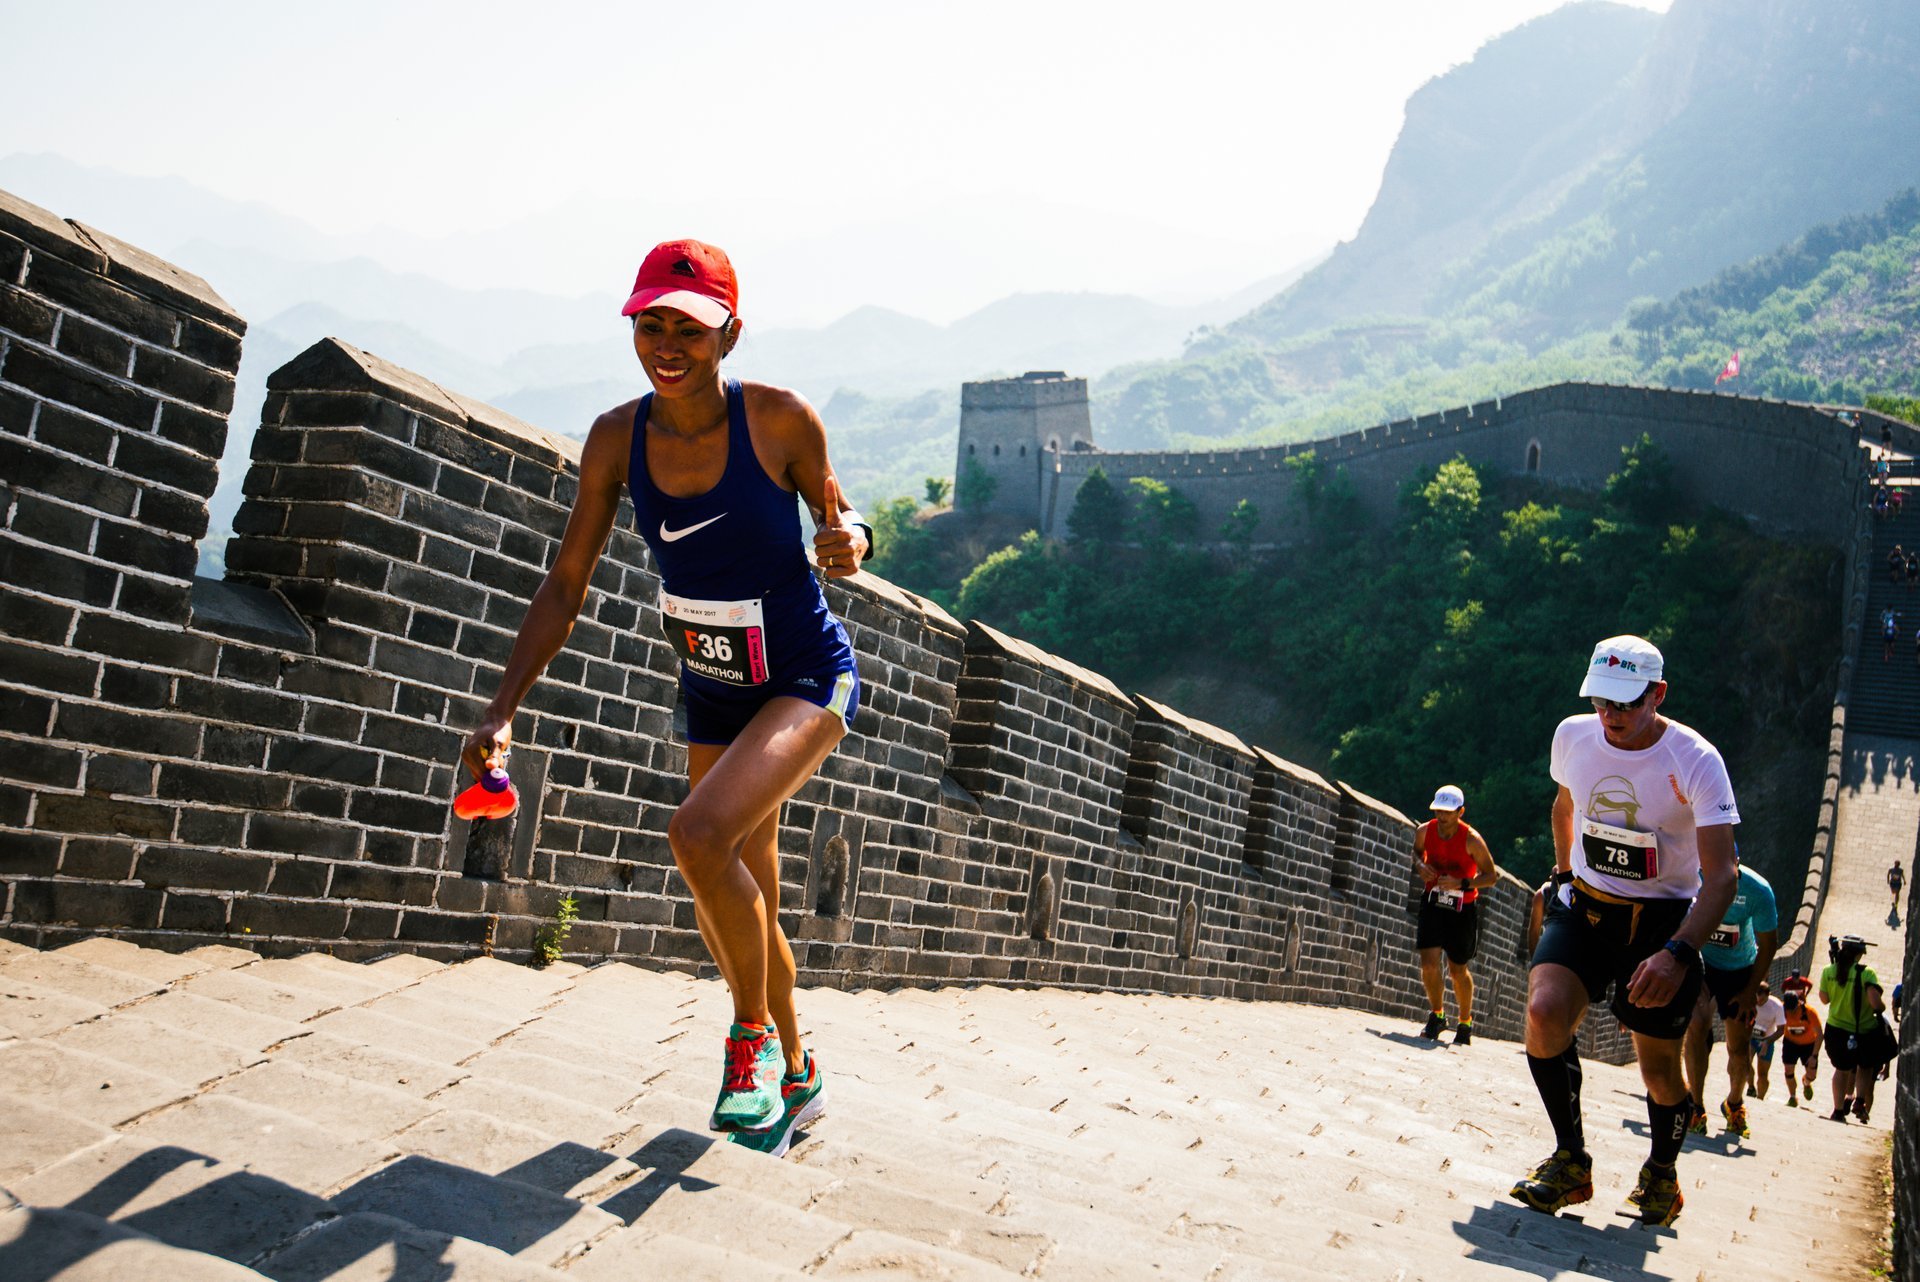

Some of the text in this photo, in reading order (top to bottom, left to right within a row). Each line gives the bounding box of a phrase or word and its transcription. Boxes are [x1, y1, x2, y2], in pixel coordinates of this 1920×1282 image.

[684, 629, 733, 662] F36
[686, 658, 744, 681] MARATHON
[1605, 846, 1629, 866] 78
[1595, 863, 1642, 879] MARATHON
[1710, 932, 1726, 941] 07
